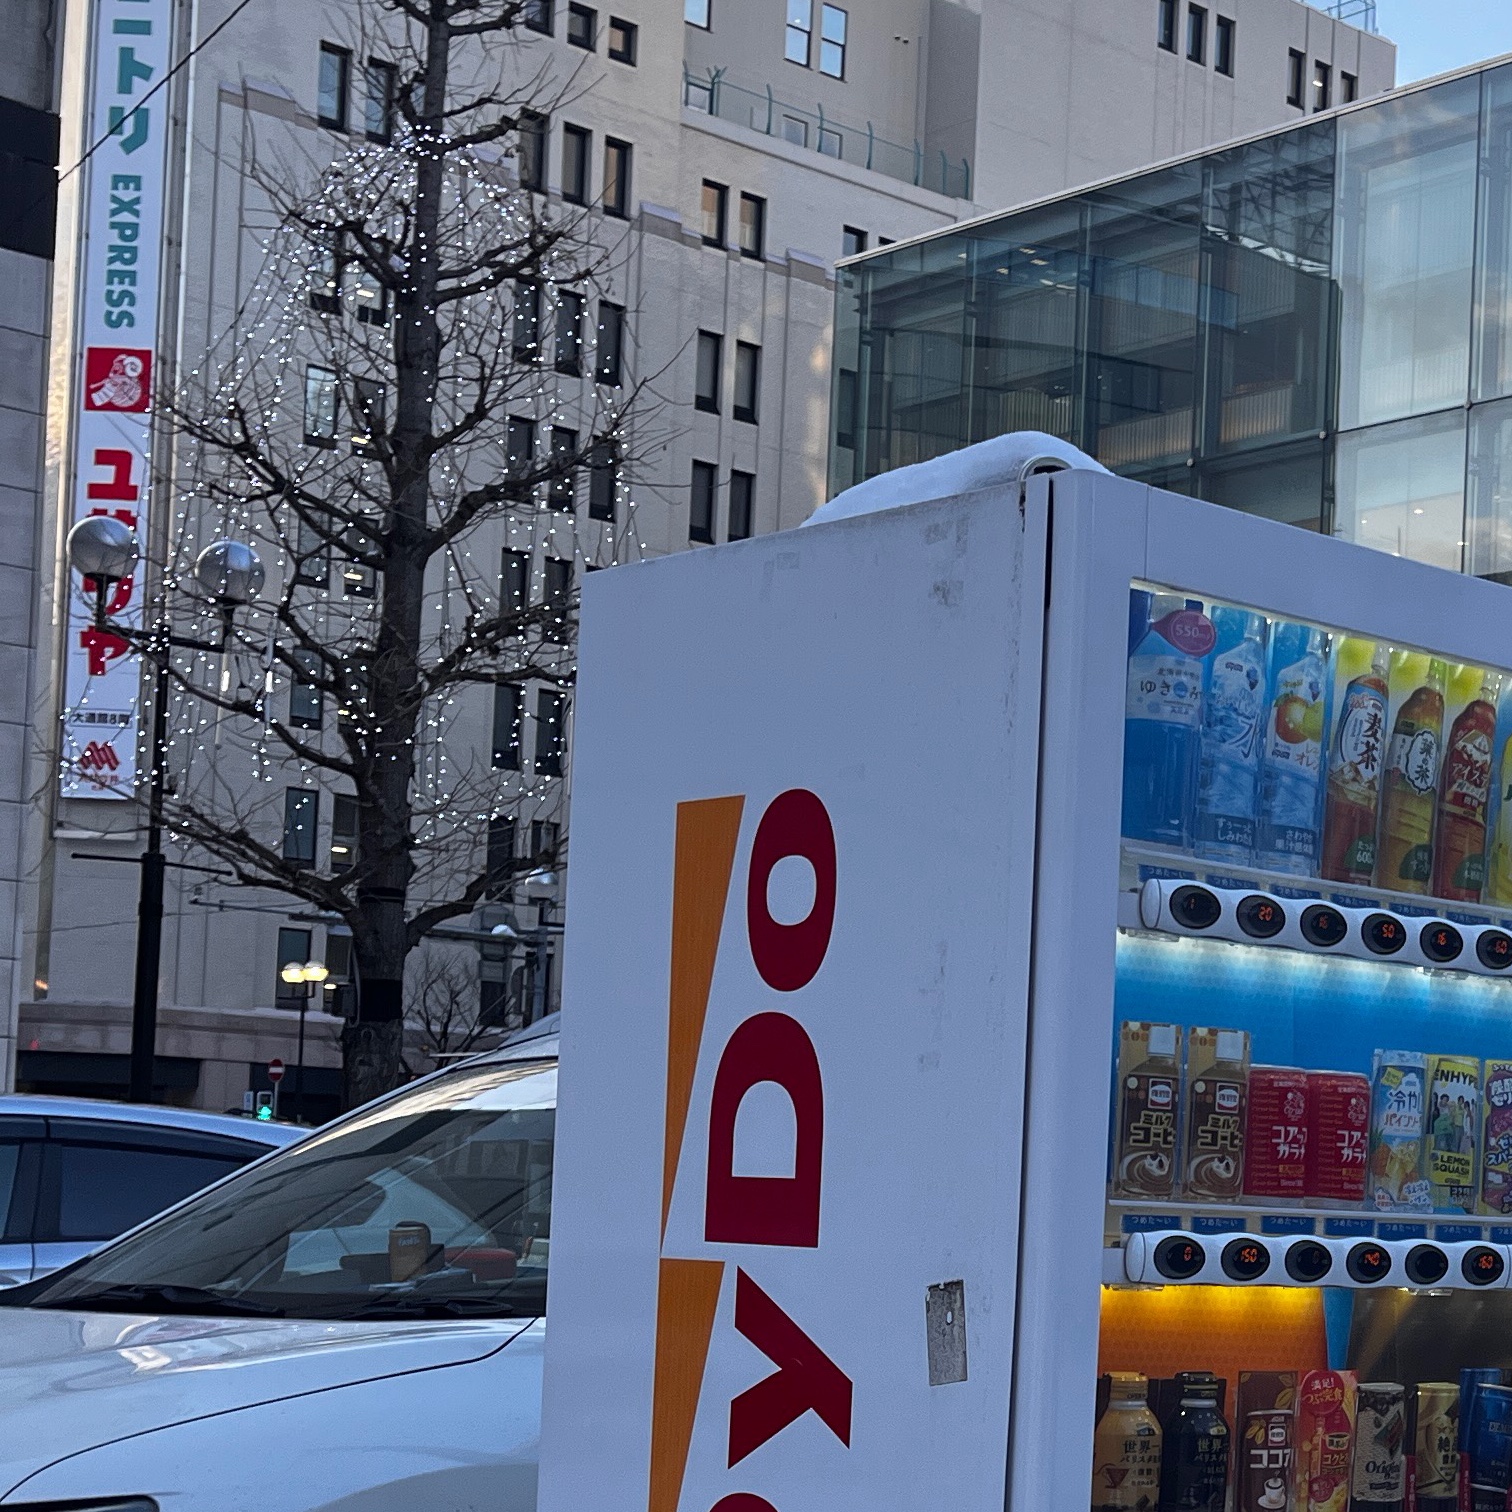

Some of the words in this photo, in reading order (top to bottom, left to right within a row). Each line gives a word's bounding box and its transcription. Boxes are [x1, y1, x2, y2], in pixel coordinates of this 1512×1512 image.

[104, 173, 143, 331] EXPRESS
[1358, 711, 1383, 772] 麦茶
[1440, 1154, 1471, 1166] LEMON
